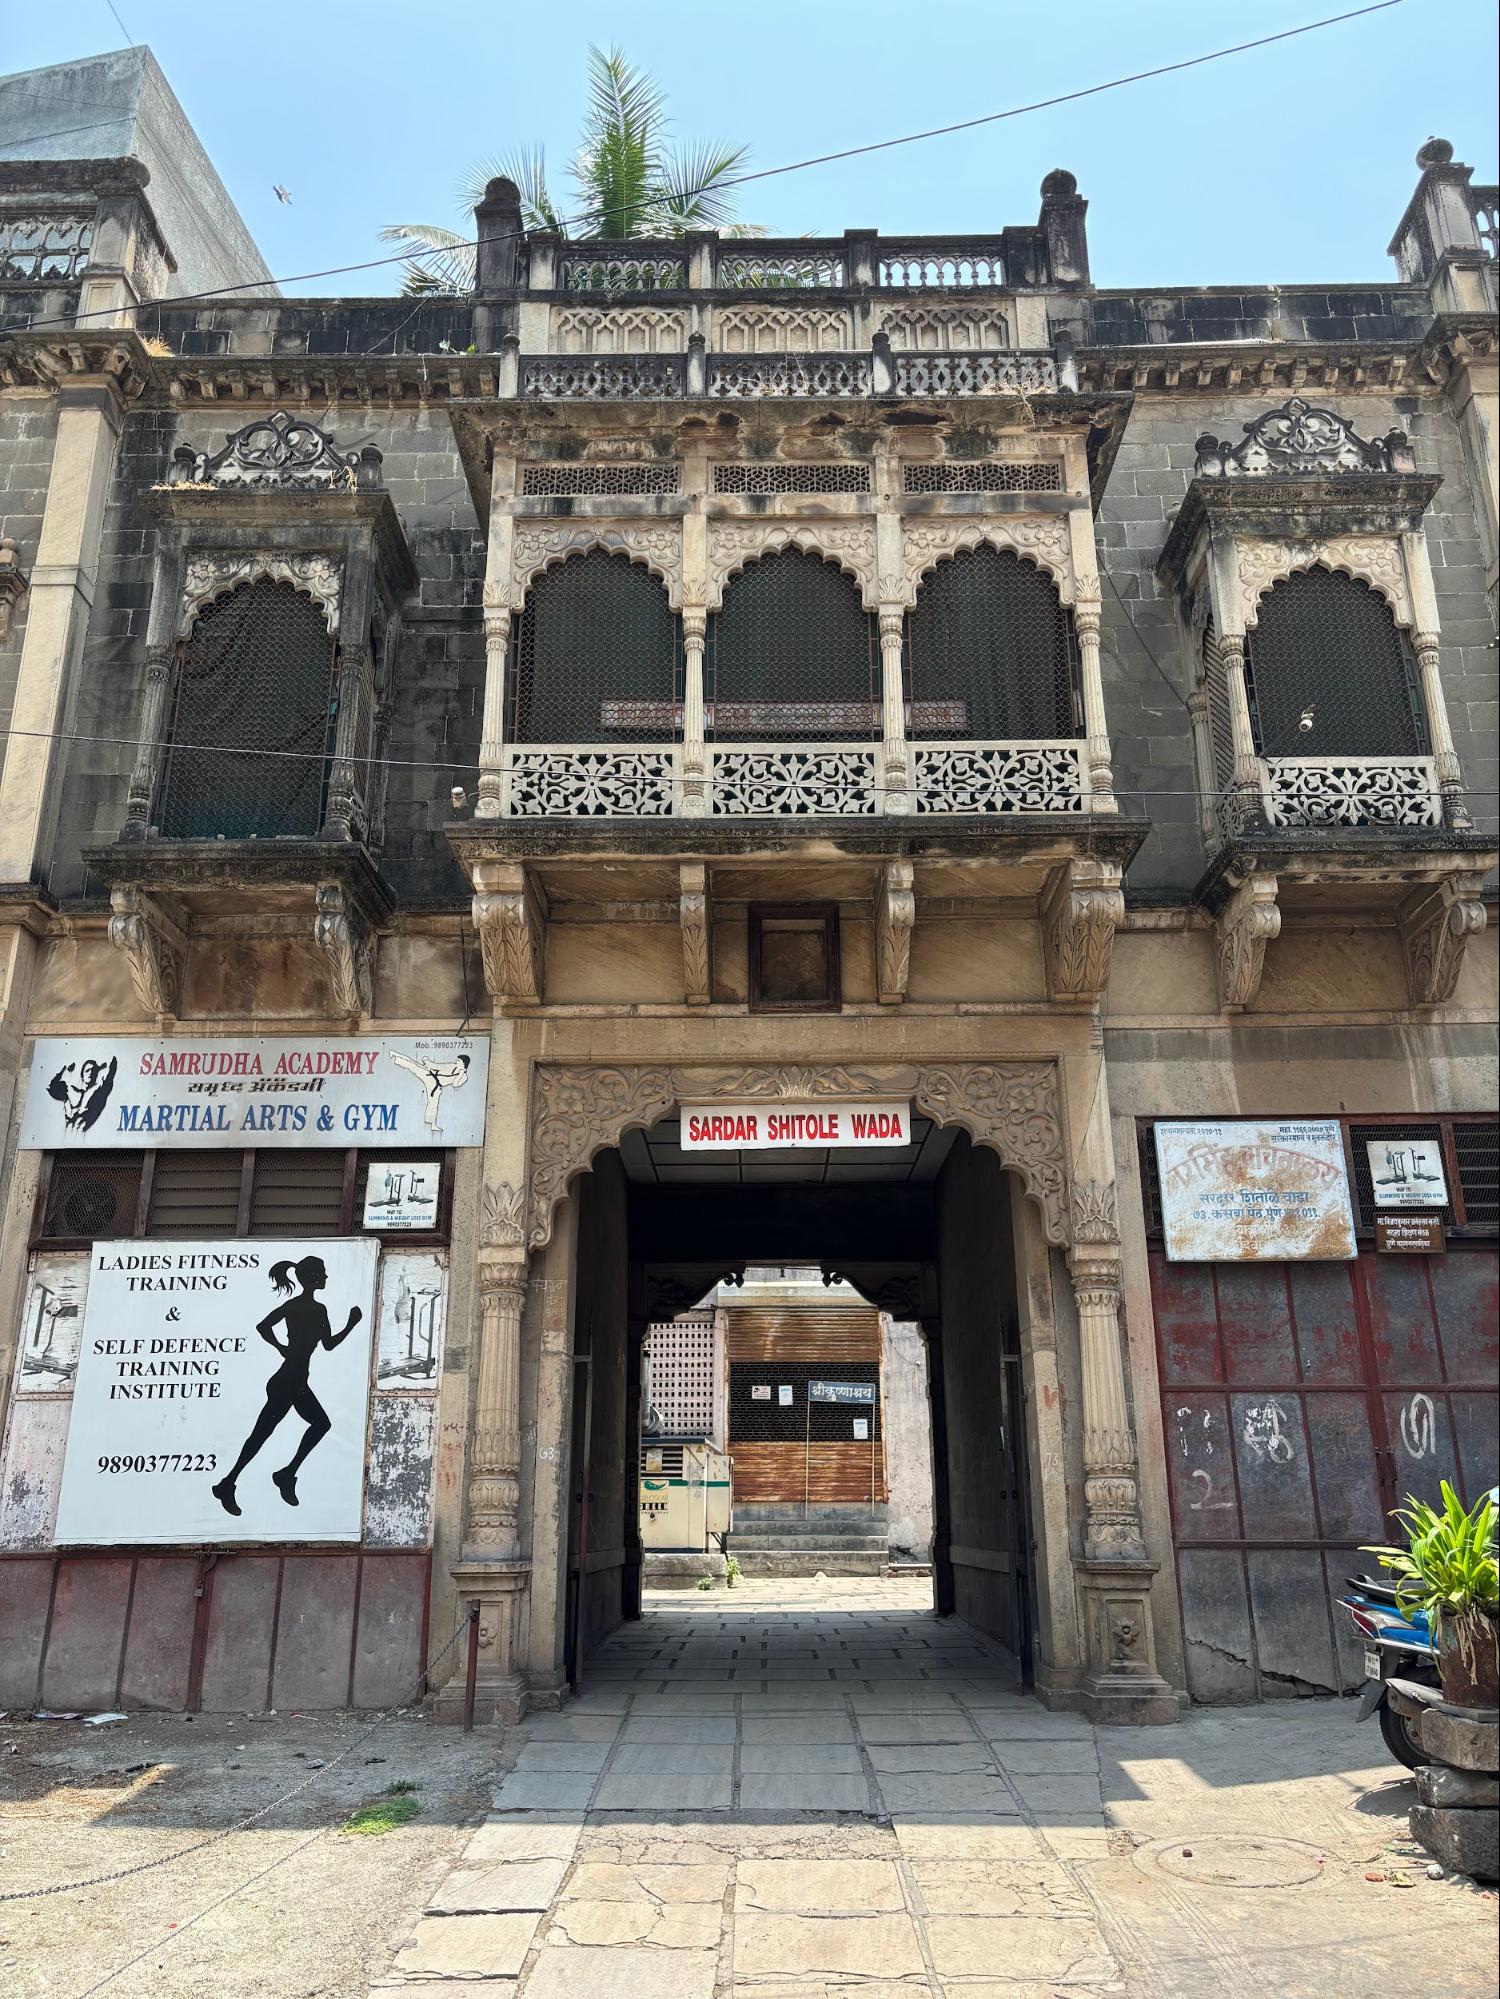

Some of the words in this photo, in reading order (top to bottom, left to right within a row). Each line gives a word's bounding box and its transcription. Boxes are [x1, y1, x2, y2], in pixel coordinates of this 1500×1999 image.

[139, 1052, 264, 1076] SAMRUDHA
[273, 1051, 380, 1075] ACADEMY
[116, 1104, 231, 1132] MARTIAL
[235, 1104, 307, 1132] ARTS
[317, 1104, 335, 1132] &
[343, 1104, 400, 1132] GYM
[689, 1115, 758, 1142] SARDAR
[767, 1113, 839, 1140] SHITOLE
[851, 1113, 903, 1139] WADA
[98, 1255, 172, 1271] LADIES
[178, 1253, 260, 1270] FITNESS
[126, 1275, 228, 1291] TRAINING
[165, 1306, 181, 1322] &
[93, 1339, 145, 1355] SELF
[149, 1337, 246, 1354] DEFENCE
[116, 1360, 220, 1377] TRAINING
[109, 1382, 221, 1400] INSTITUTE
[97, 1453, 217, 1474] 9890377223
